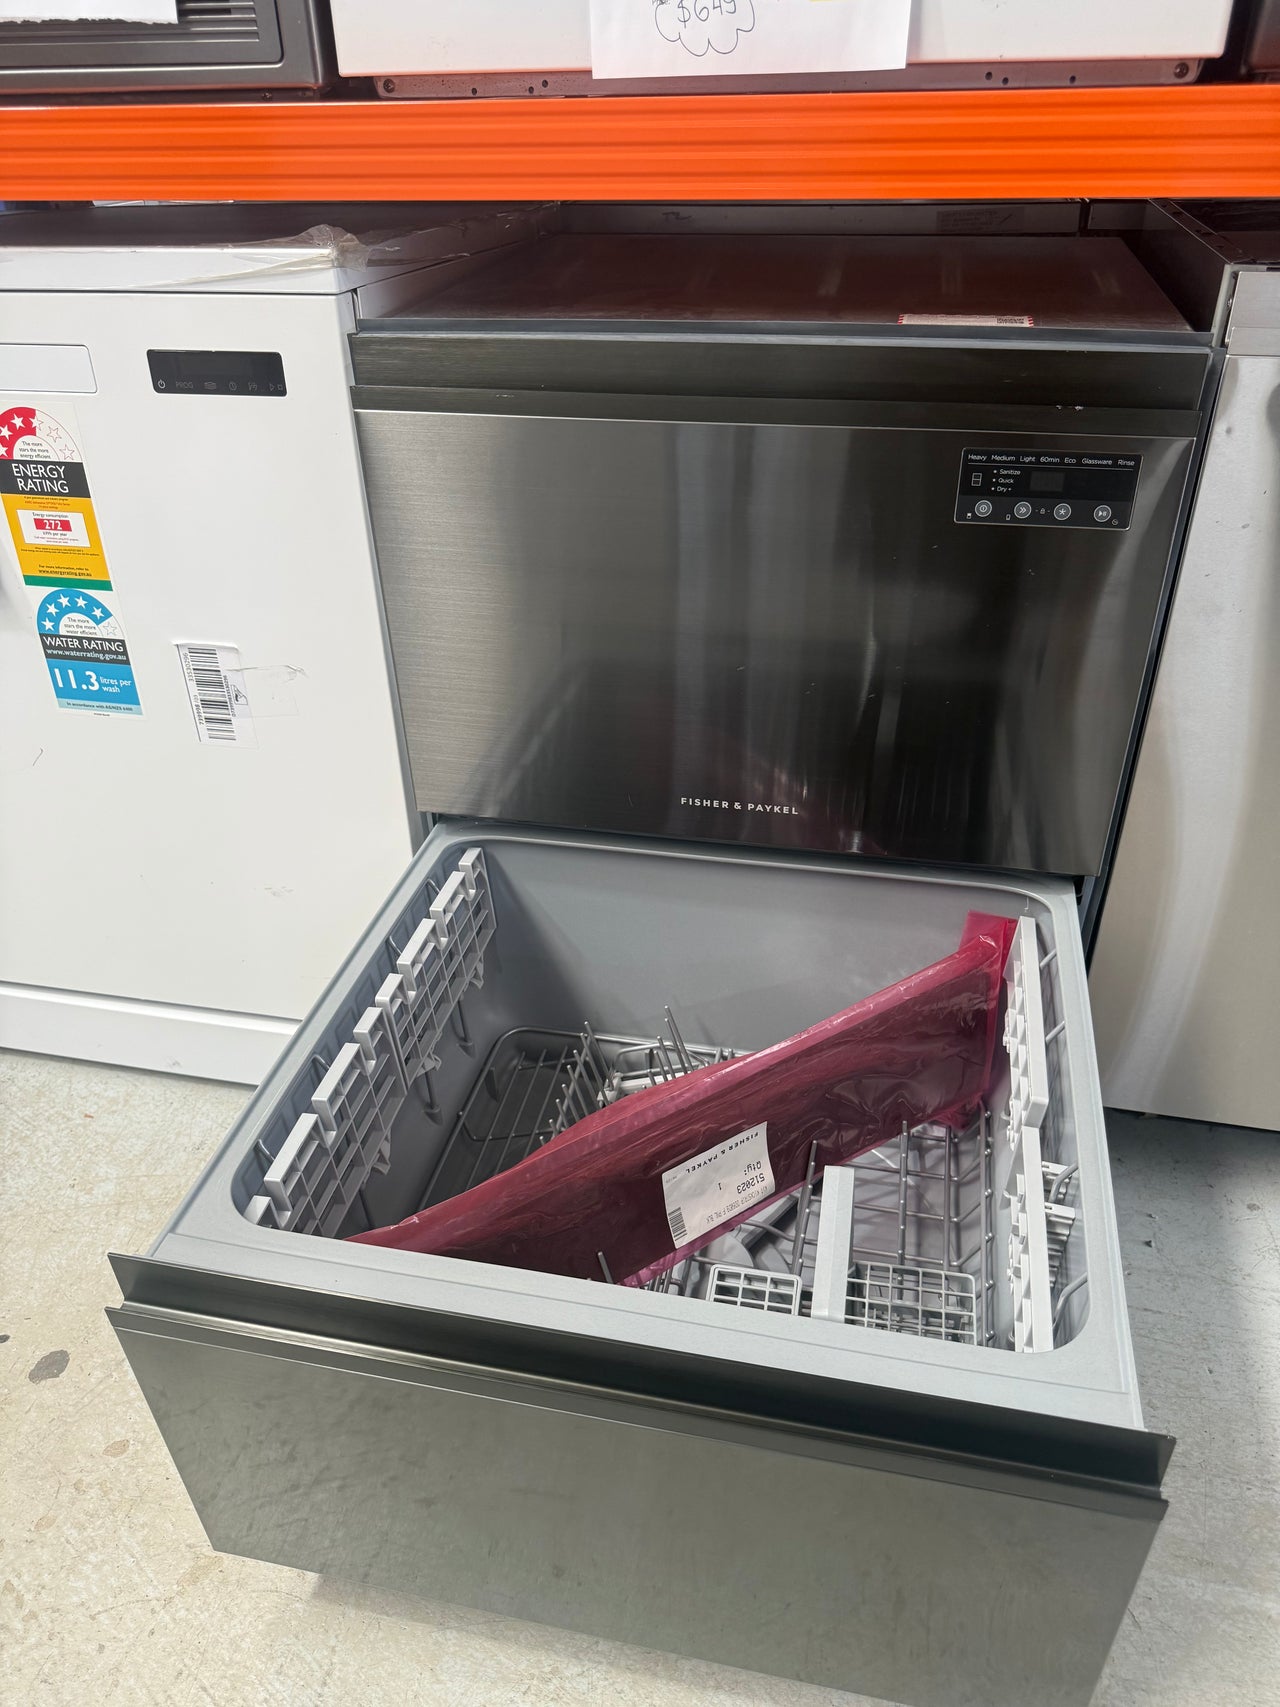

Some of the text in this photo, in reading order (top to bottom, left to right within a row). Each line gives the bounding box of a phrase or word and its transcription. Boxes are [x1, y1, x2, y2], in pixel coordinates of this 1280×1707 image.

[12, 463, 65, 479] ENERGY
[16, 478, 69, 493] RATING
[43, 519, 63, 530] 272
[43, 636, 124, 652] WATER RATING
[46, 648, 127, 660] www.waterrating.gov.au
[54, 667, 100, 691] 11.3
[100, 676, 131, 687] litres per
[102, 685, 120, 693] wash
[680, 797, 799, 815] FISHER & PAYKEL
[728, 1131, 759, 1151] FISHER
[685, 1153, 718, 1174] PAYKEL
[718, 1160, 762, 1191] Qty: 1
[736, 1172, 766, 1194] 512023
